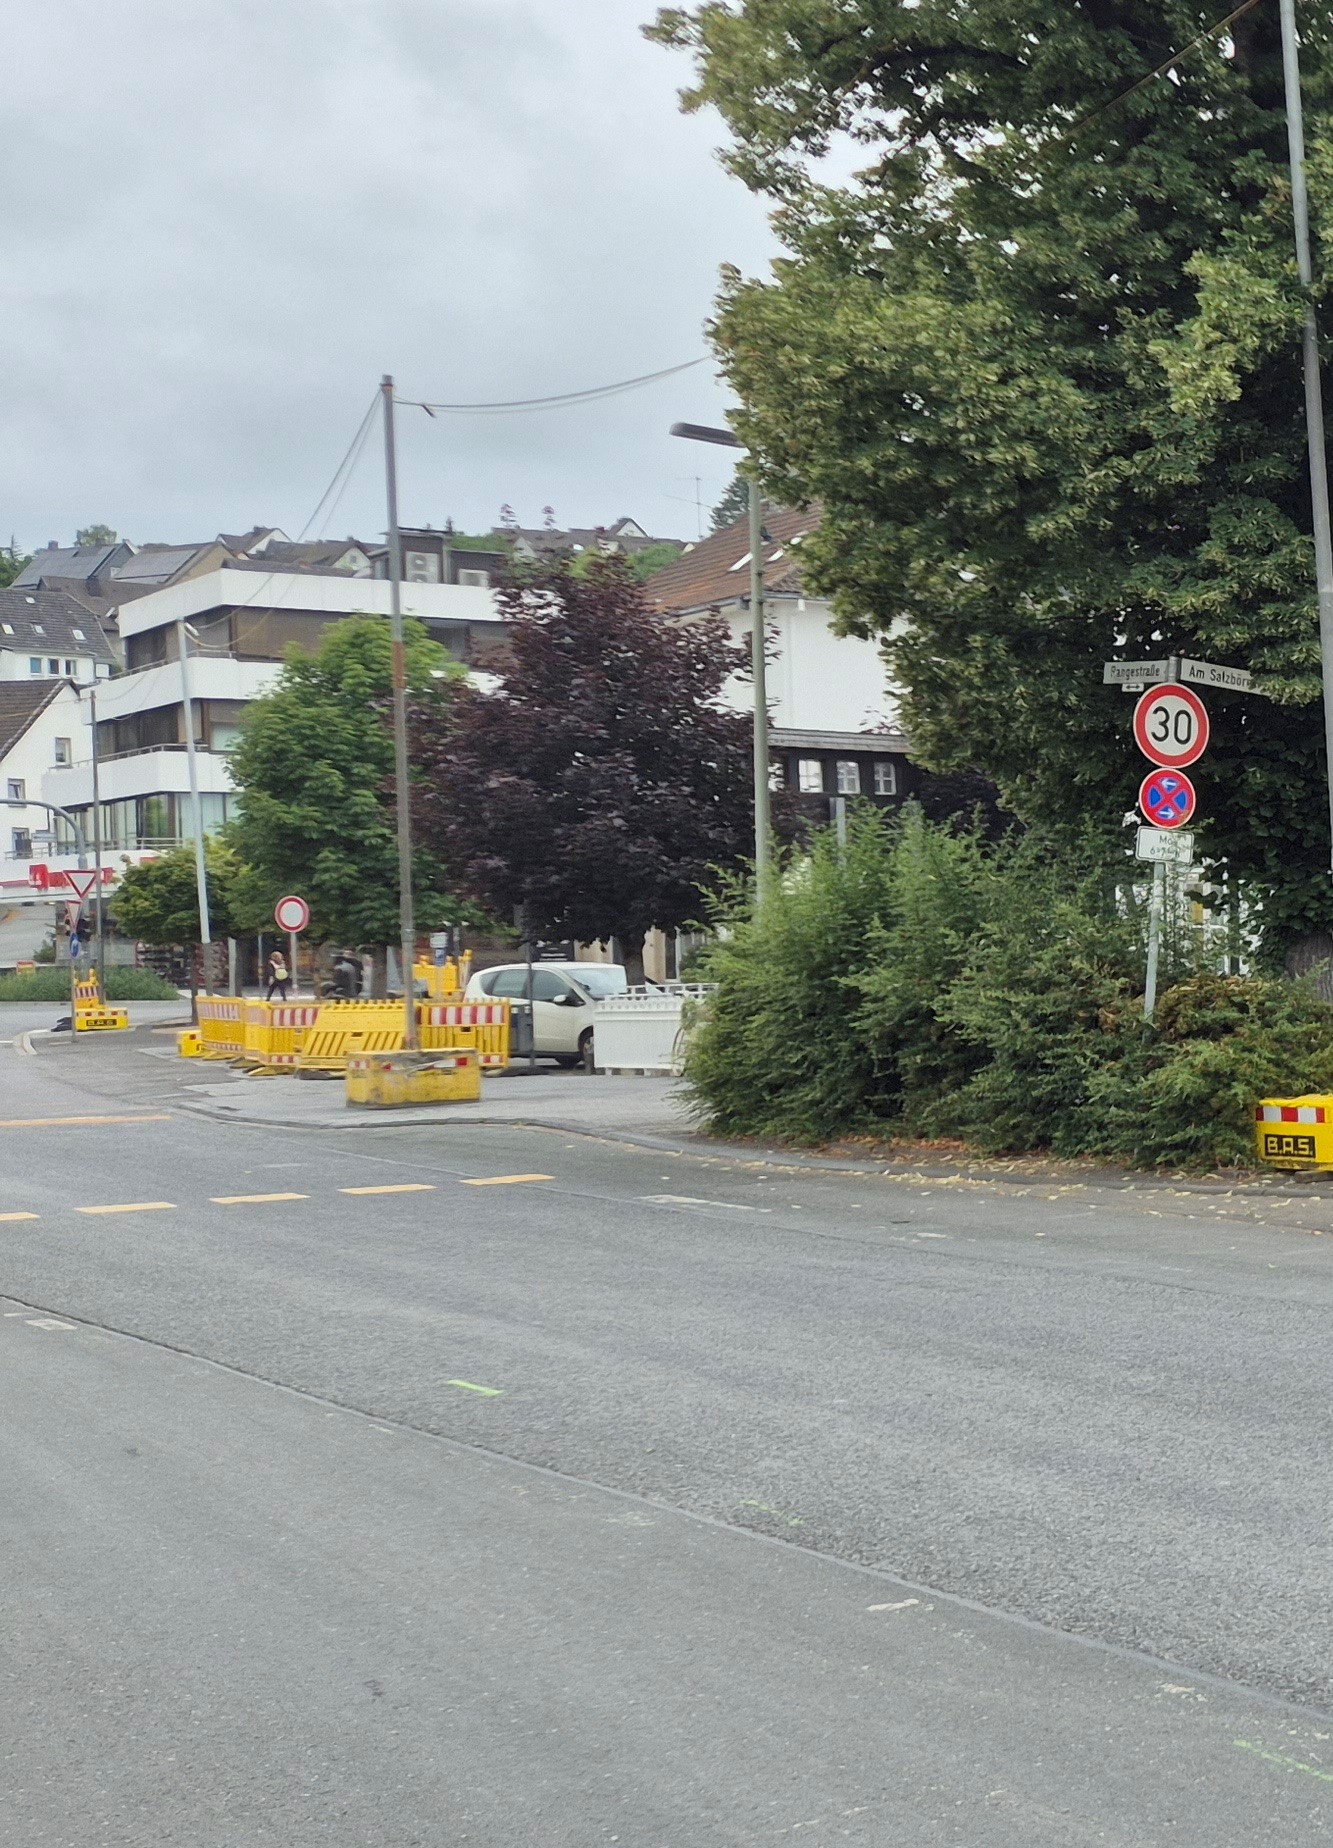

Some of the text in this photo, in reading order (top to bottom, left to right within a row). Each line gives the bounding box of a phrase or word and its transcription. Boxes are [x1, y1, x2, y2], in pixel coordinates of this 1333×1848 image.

[1189, 665, 1205, 679] Am
[1151, 706, 1192, 745] 30
[1267, 1136, 1314, 1155] B.A.S.
